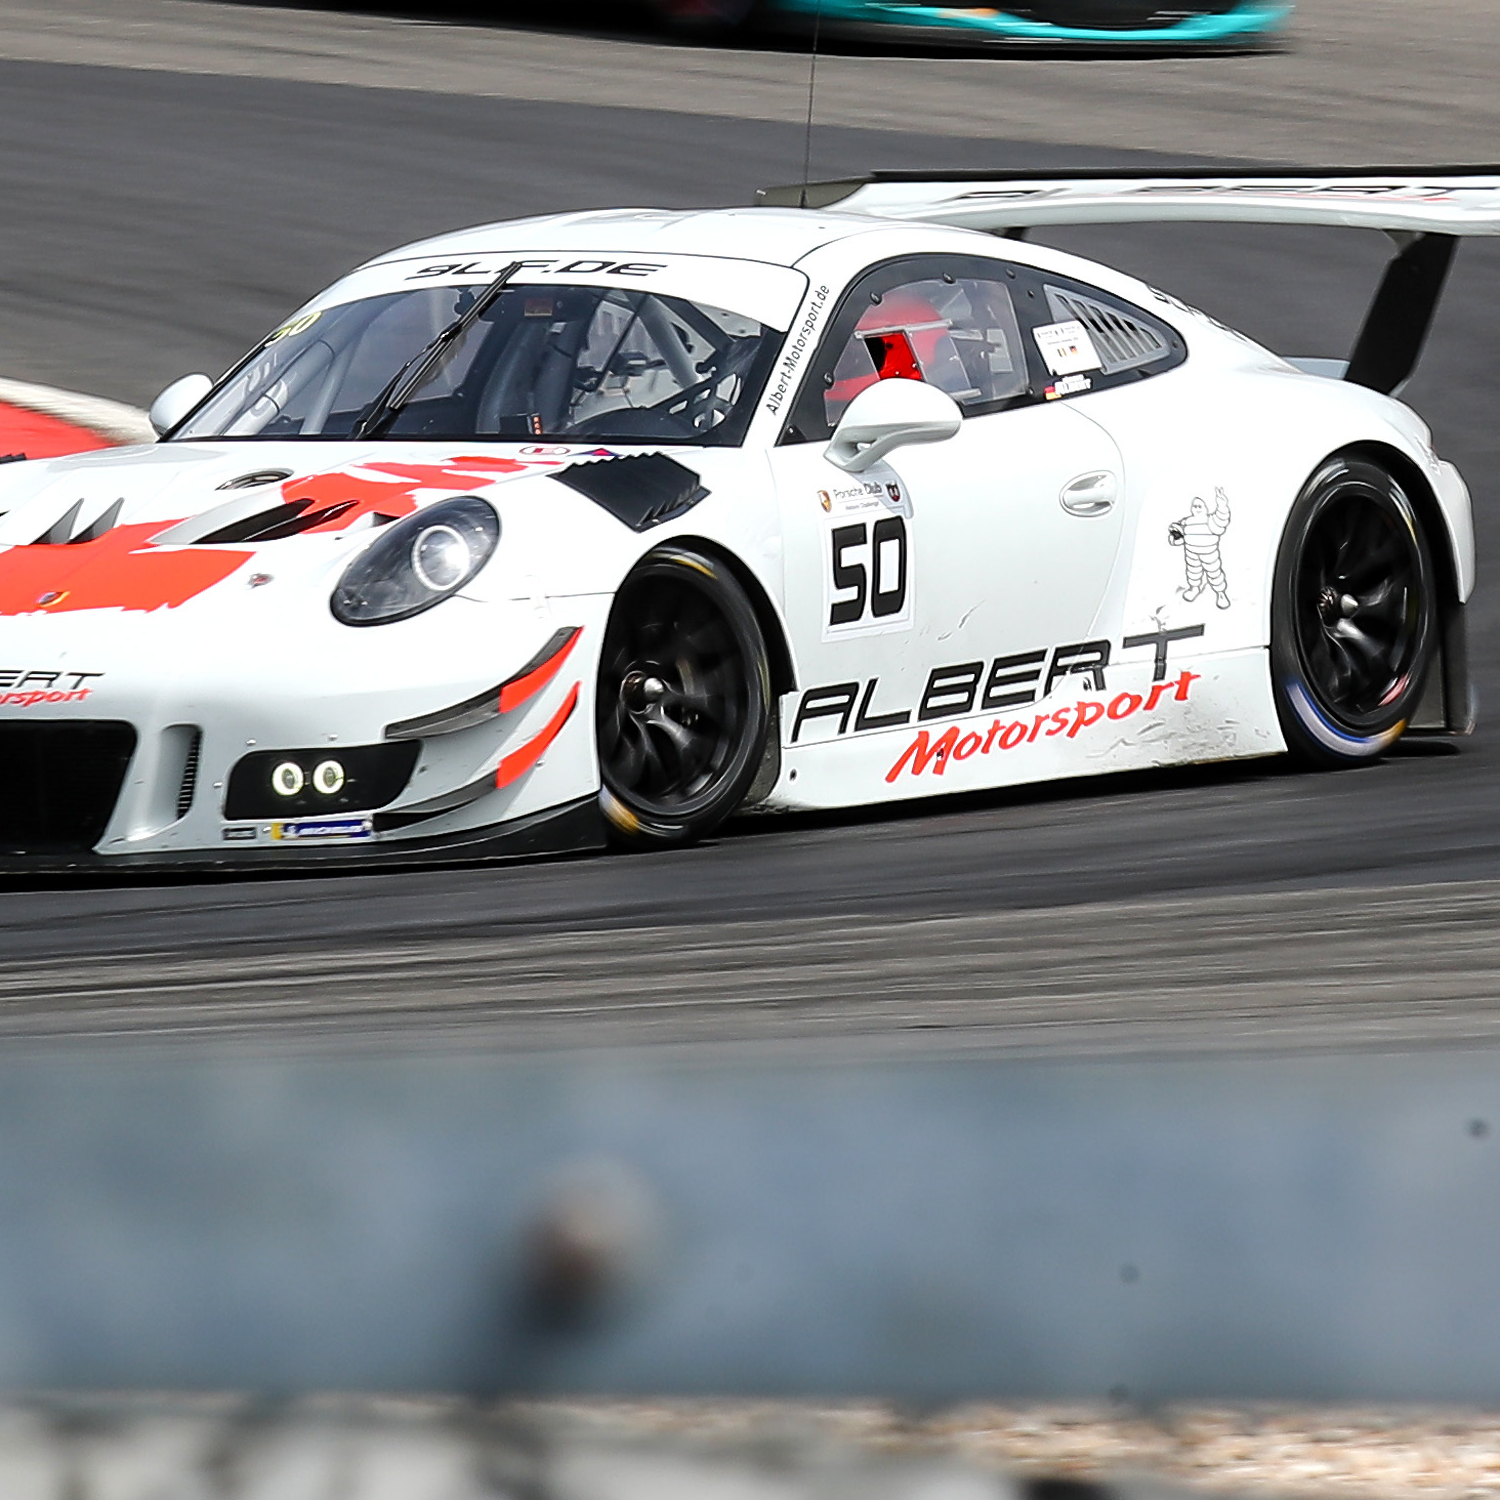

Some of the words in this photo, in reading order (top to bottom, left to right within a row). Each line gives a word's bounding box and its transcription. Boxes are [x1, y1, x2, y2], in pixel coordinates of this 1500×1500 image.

[766, 285, 830, 416] Albert-Motorsport.de
[829, 515, 907, 626] 50
[791, 623, 1205, 743] ALBERT
[885, 671, 1201, 783] Motorsport
